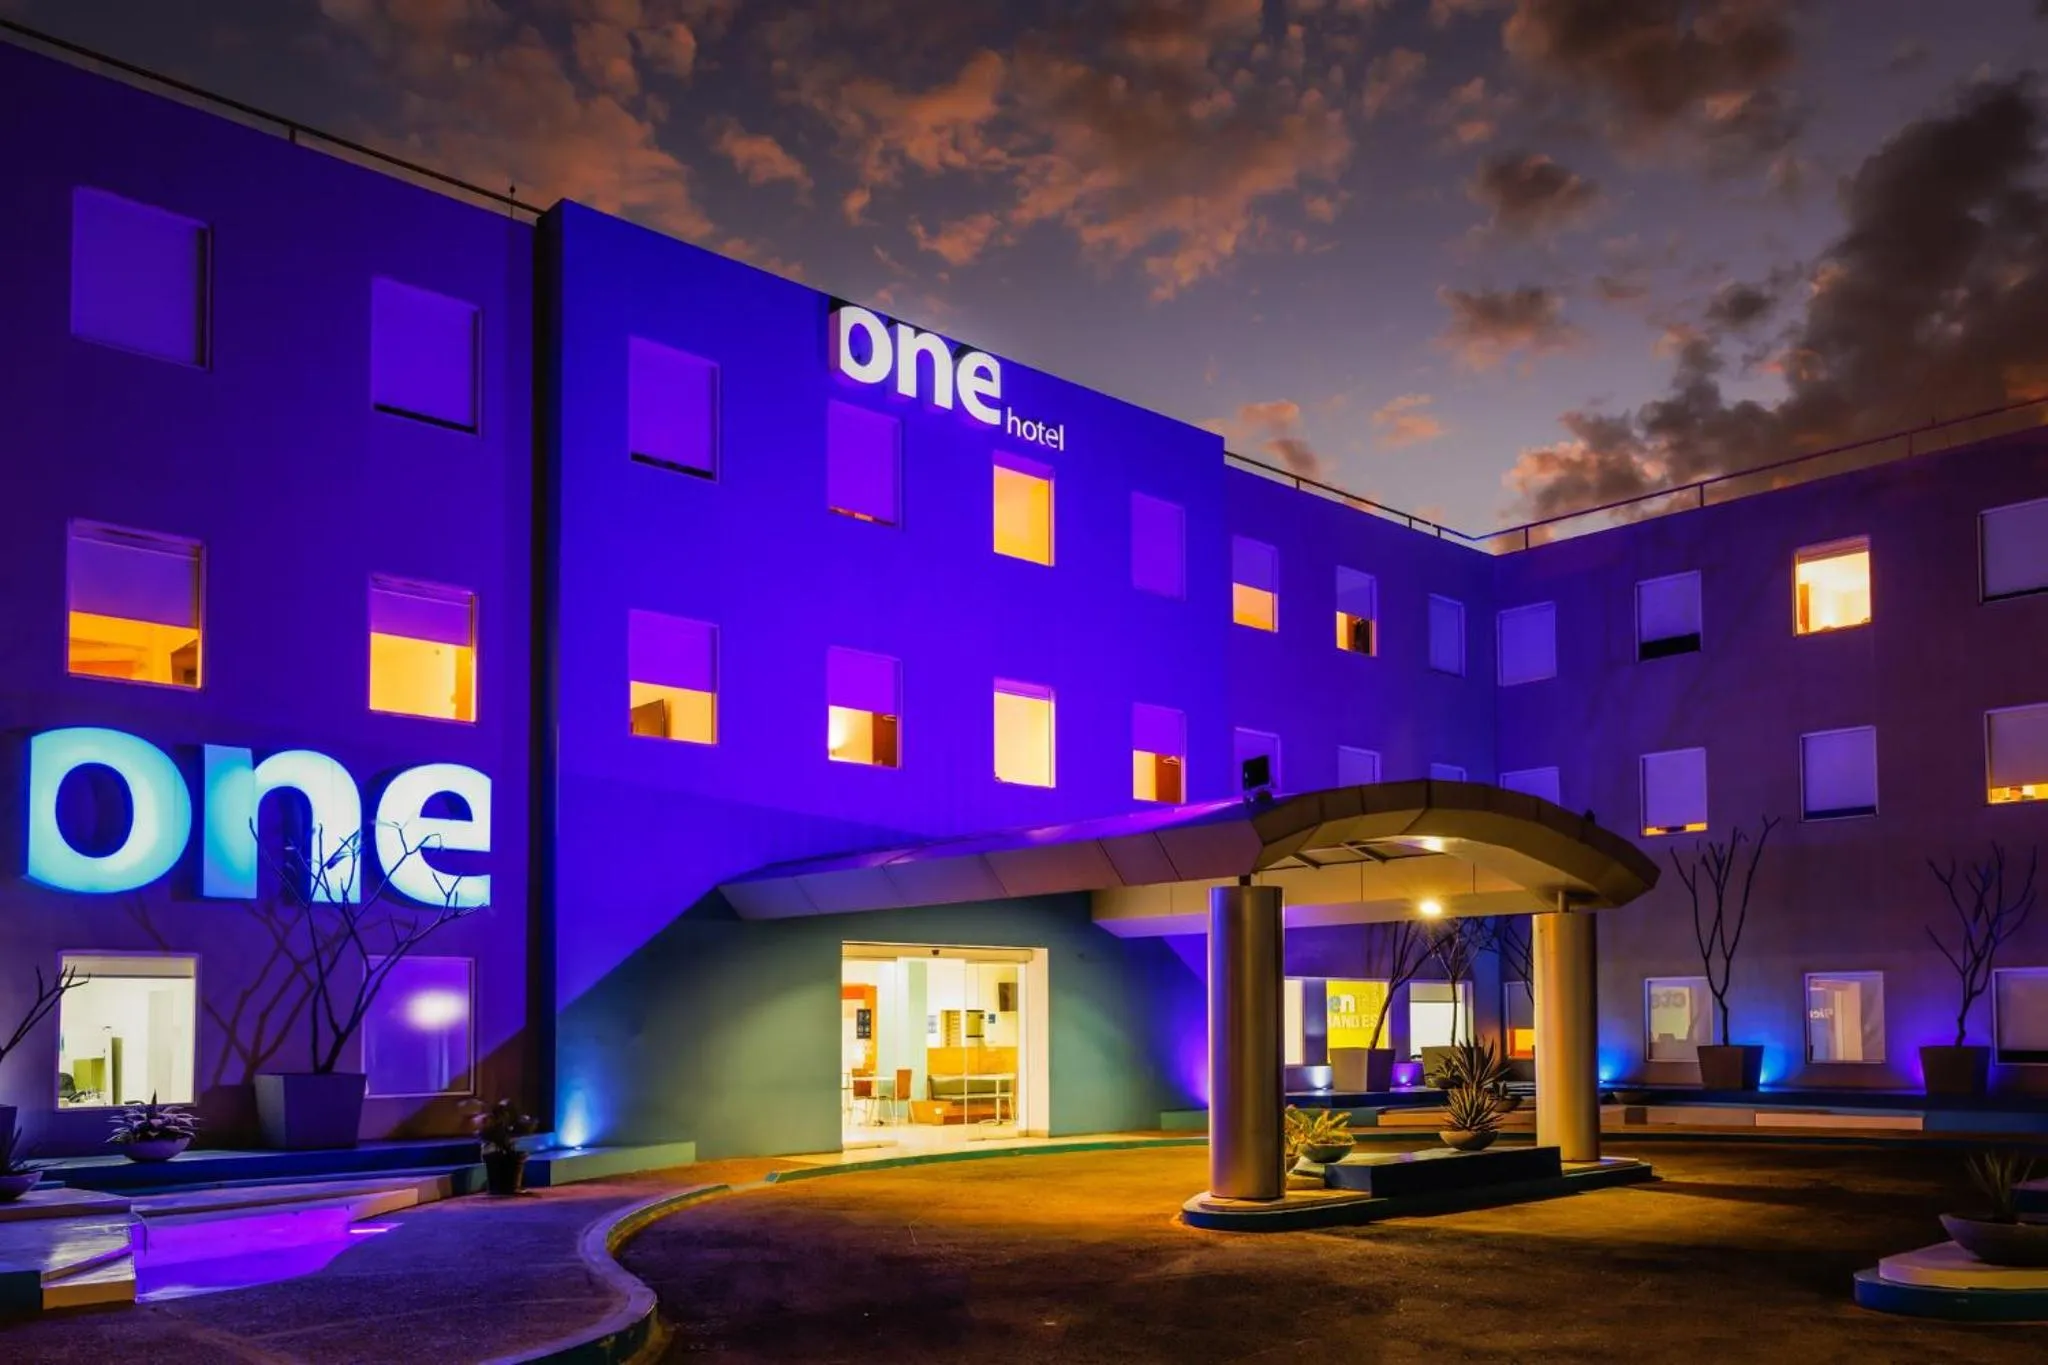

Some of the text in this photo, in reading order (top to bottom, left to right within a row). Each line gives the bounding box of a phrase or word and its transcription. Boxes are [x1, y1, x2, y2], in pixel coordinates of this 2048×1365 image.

[839, 305, 1002, 426] one
[1006, 406, 1065, 452] hotel
[27, 727, 492, 908] one
